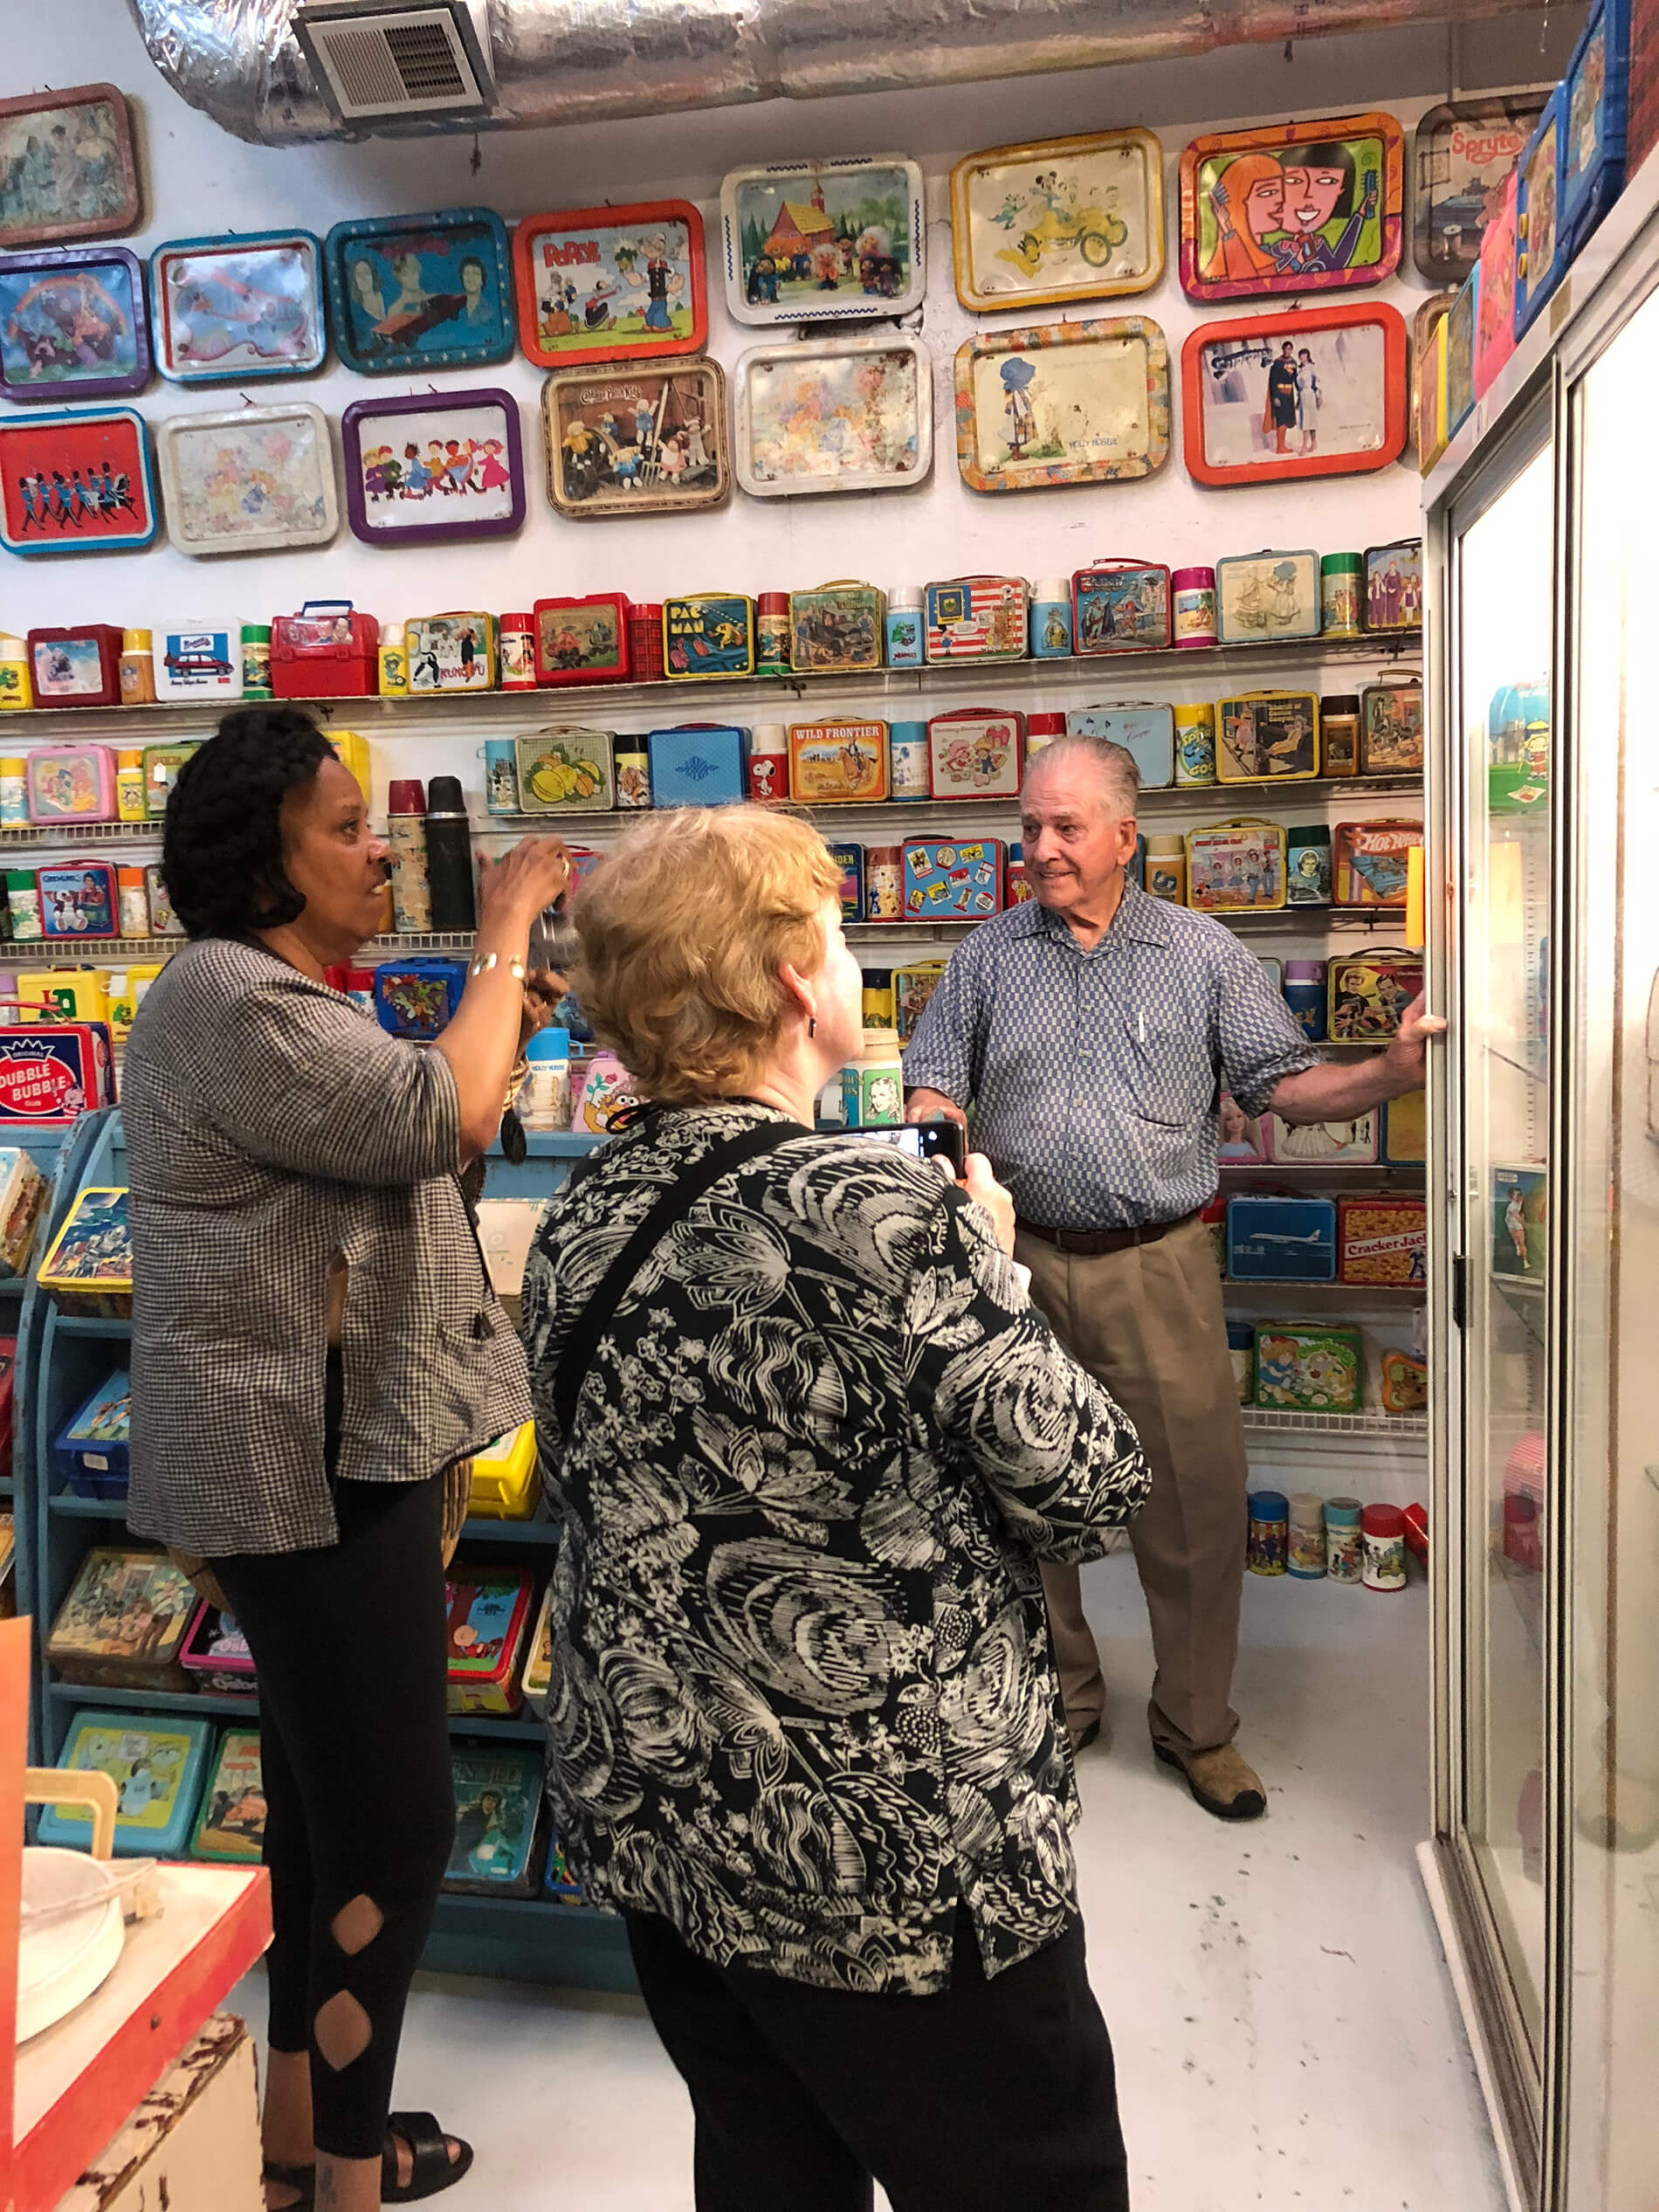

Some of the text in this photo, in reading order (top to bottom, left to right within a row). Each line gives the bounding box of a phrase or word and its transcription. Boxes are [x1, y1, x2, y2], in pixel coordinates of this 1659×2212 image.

[1451, 130, 1521, 164] Spryte
[543, 240, 601, 268] POPEYE
[670, 604, 702, 619] PAC
[671, 620, 704, 635] MAN
[795, 726, 880, 740] WILD FRONTIER
[0, 1063, 51, 1089] DUBBLE
[12, 1075, 66, 1102] BUBBLE
[1347, 1240, 1399, 1255] Cracker
